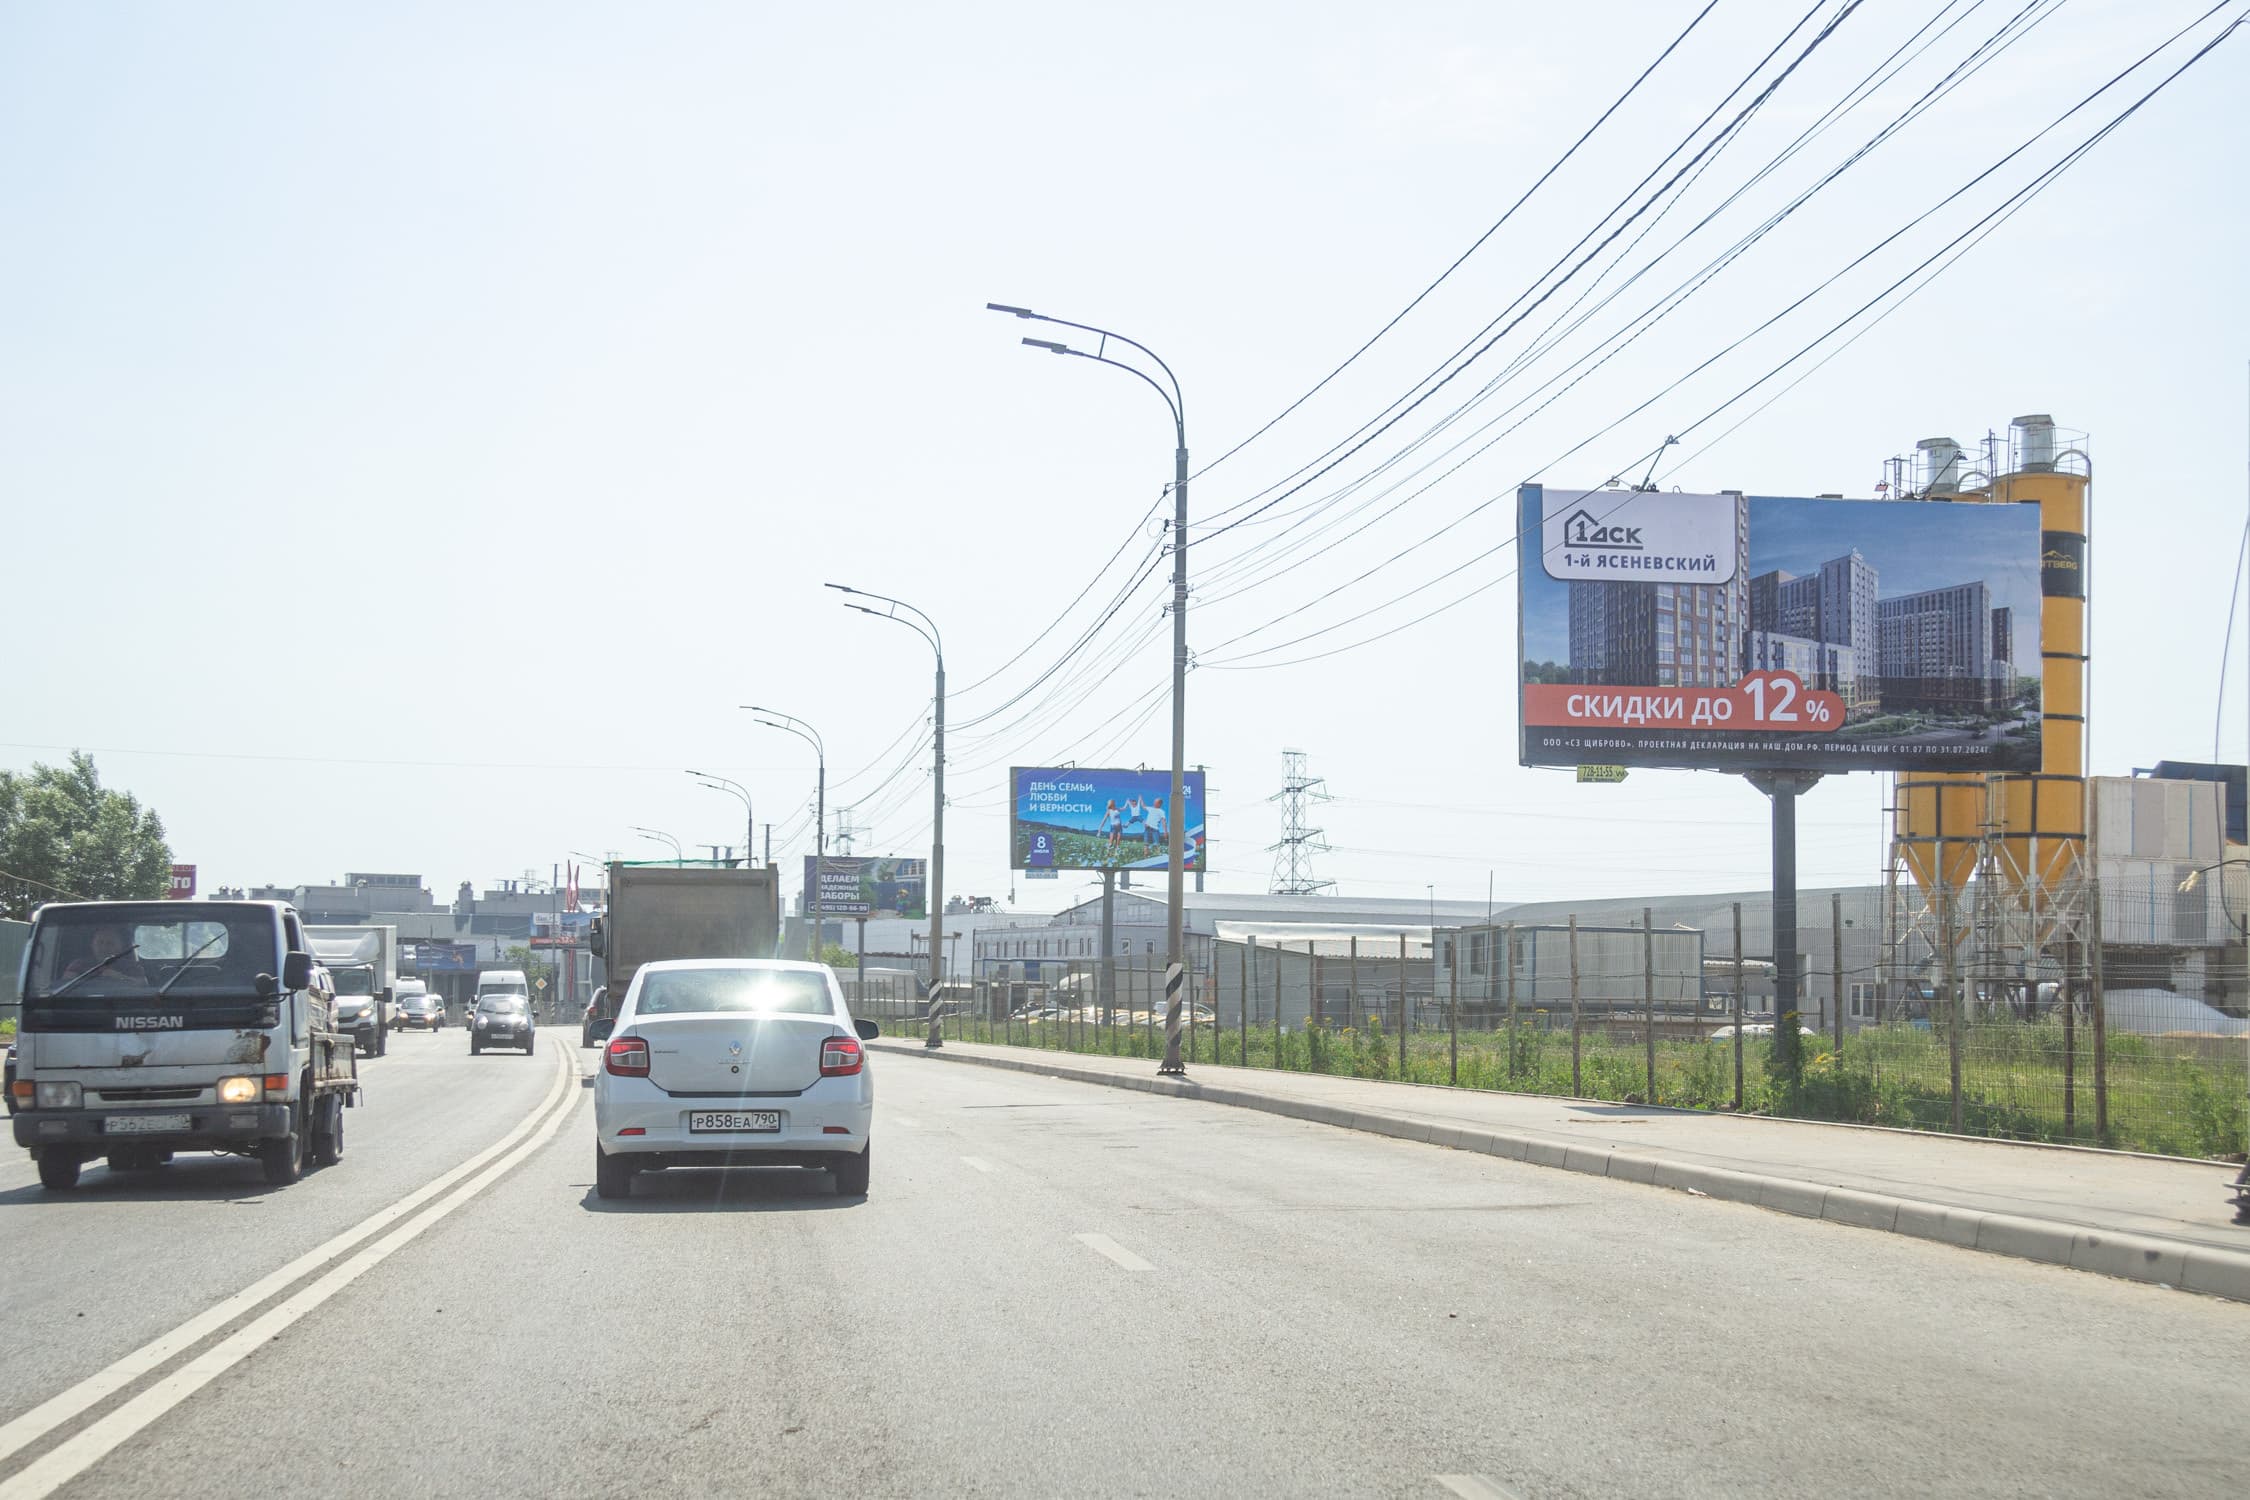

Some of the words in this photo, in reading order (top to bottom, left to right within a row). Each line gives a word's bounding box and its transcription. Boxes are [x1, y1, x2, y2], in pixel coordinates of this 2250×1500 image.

[1564, 554, 1590, 567] 1-й
[1597, 554, 1715, 572] ЯСЕНЕВСКИЙ
[1566, 694, 1684, 724] СКИДКИ
[1691, 697, 1733, 725] ДО
[1743, 678, 1798, 722] 12
[1805, 699, 1830, 723] %
[1543, 738, 1561, 747] ООО
[1638, 740, 1687, 749] ПРОЕКТНАЯ
[1690, 741, 1745, 751] ДЕКЛАРАЦИЯ
[1748, 742, 1760, 750] НА
[1824, 743, 1858, 753] ПЕРИОД
[1860, 744, 1889, 754] АКЦИИ
[1892, 745, 1897, 753] С
[1900, 745, 1922, 754] 01.07
[1925, 745, 1937, 754] ПО
[1030, 781, 1056, 793] ДЕНЬ
[1058, 782, 1096, 793] СЕМЬИ,
[1030, 792, 1068, 802] ЛЮБВИ
[1029, 803, 1037, 812] И
[1039, 803, 1092, 813] ВЕРНОСТИ
[1037, 835, 1047, 849] 8
[821, 874, 860, 884] ДЕЛАЕМ
[115, 1015, 184, 1030] NISSAN
[753, 1113, 776, 1125] 790
